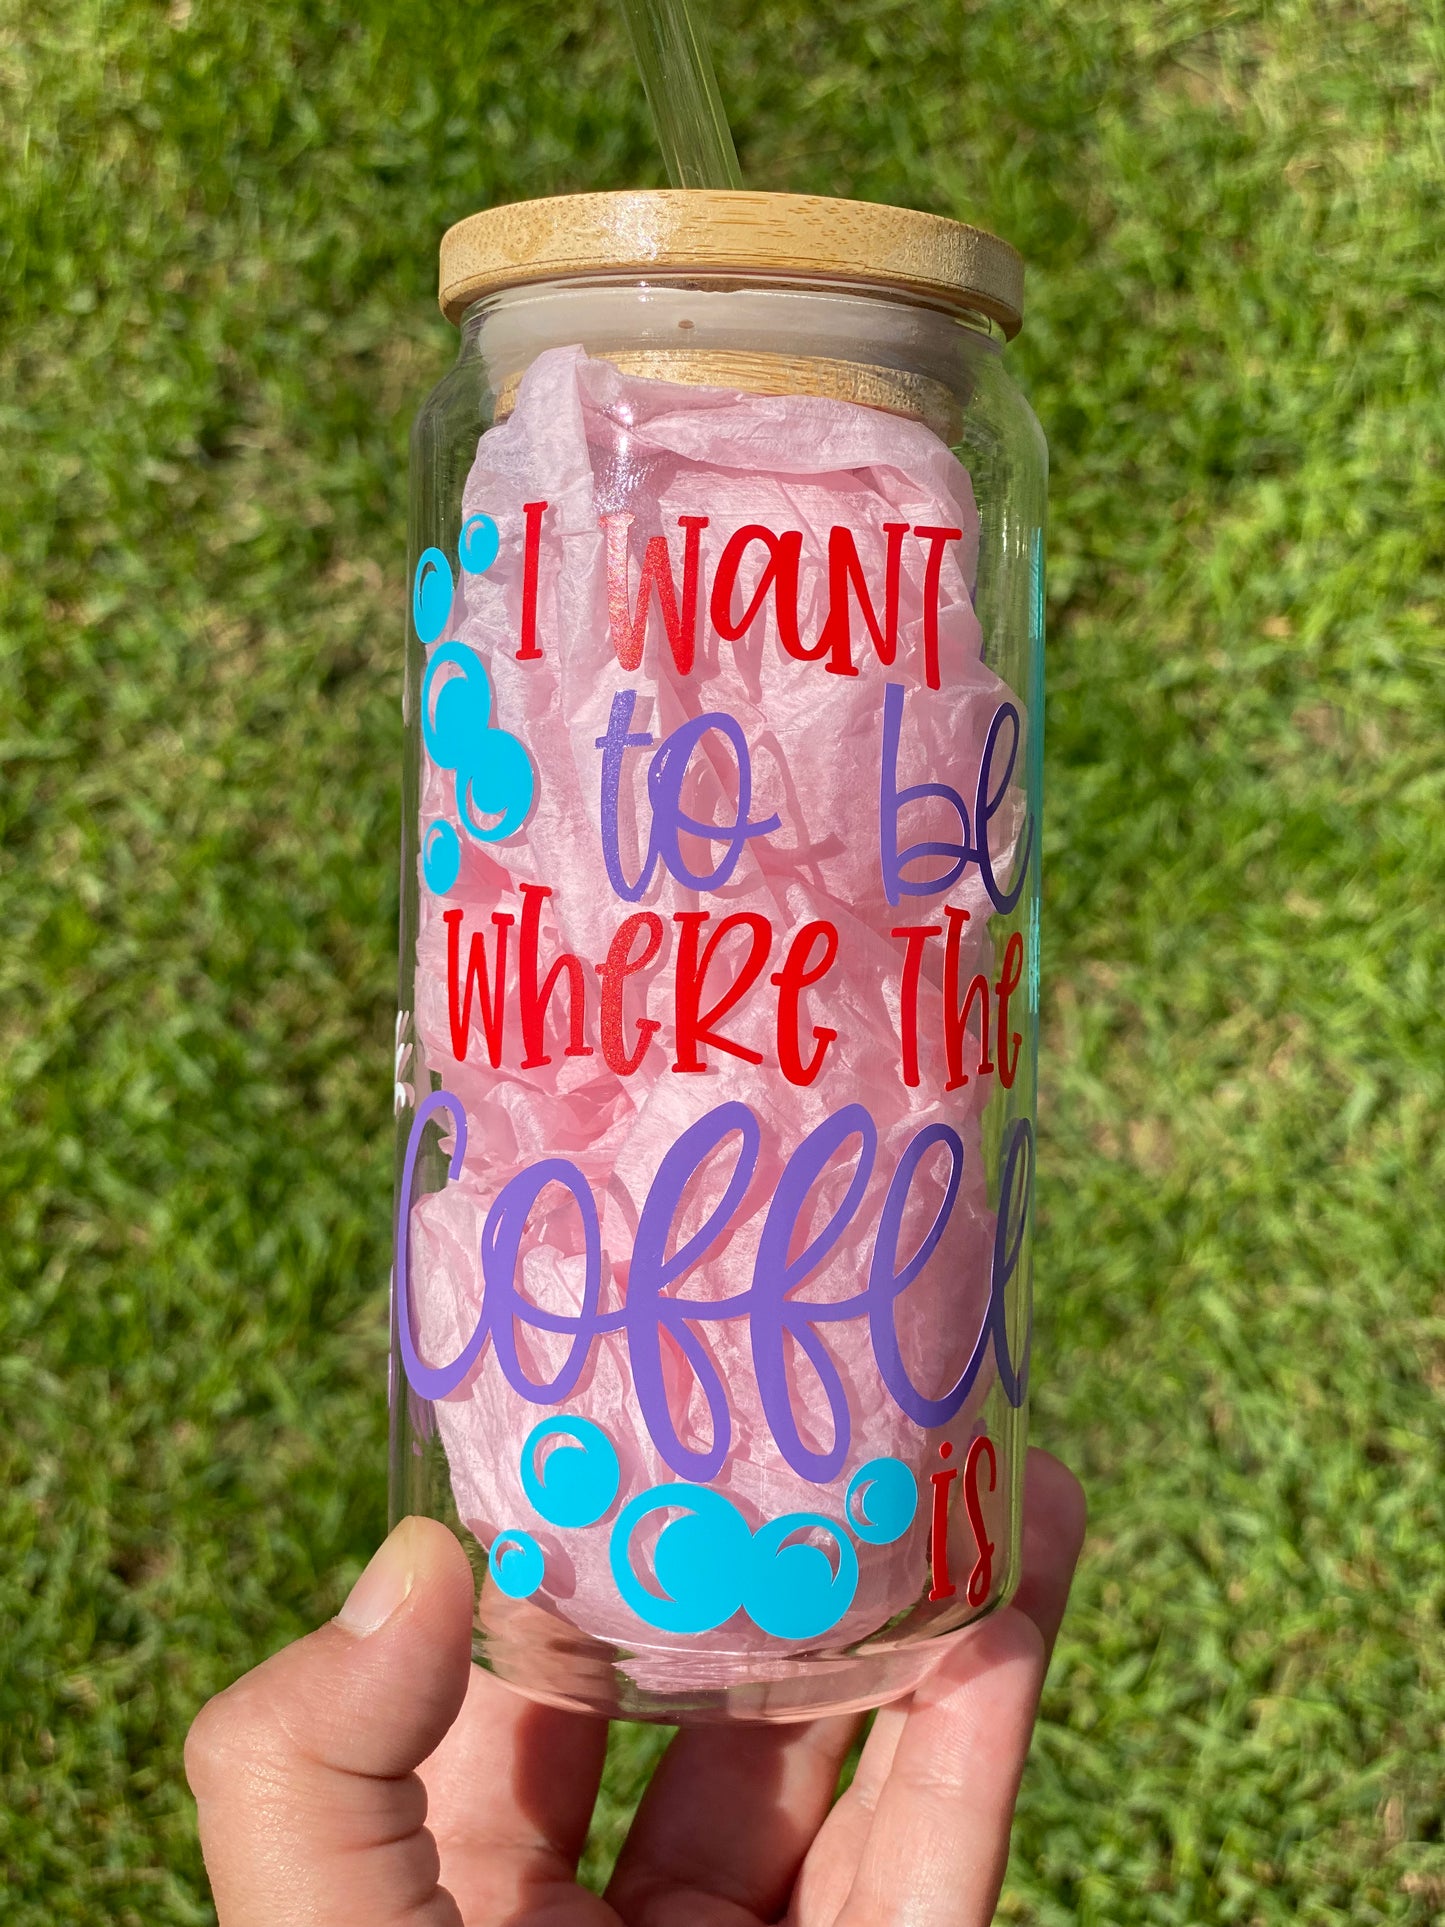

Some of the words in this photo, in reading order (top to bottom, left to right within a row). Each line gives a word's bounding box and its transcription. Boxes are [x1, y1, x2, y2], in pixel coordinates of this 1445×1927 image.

[594, 689, 782, 902] to
[880, 682, 1034, 915] be
[929, 1435, 998, 1608] is
